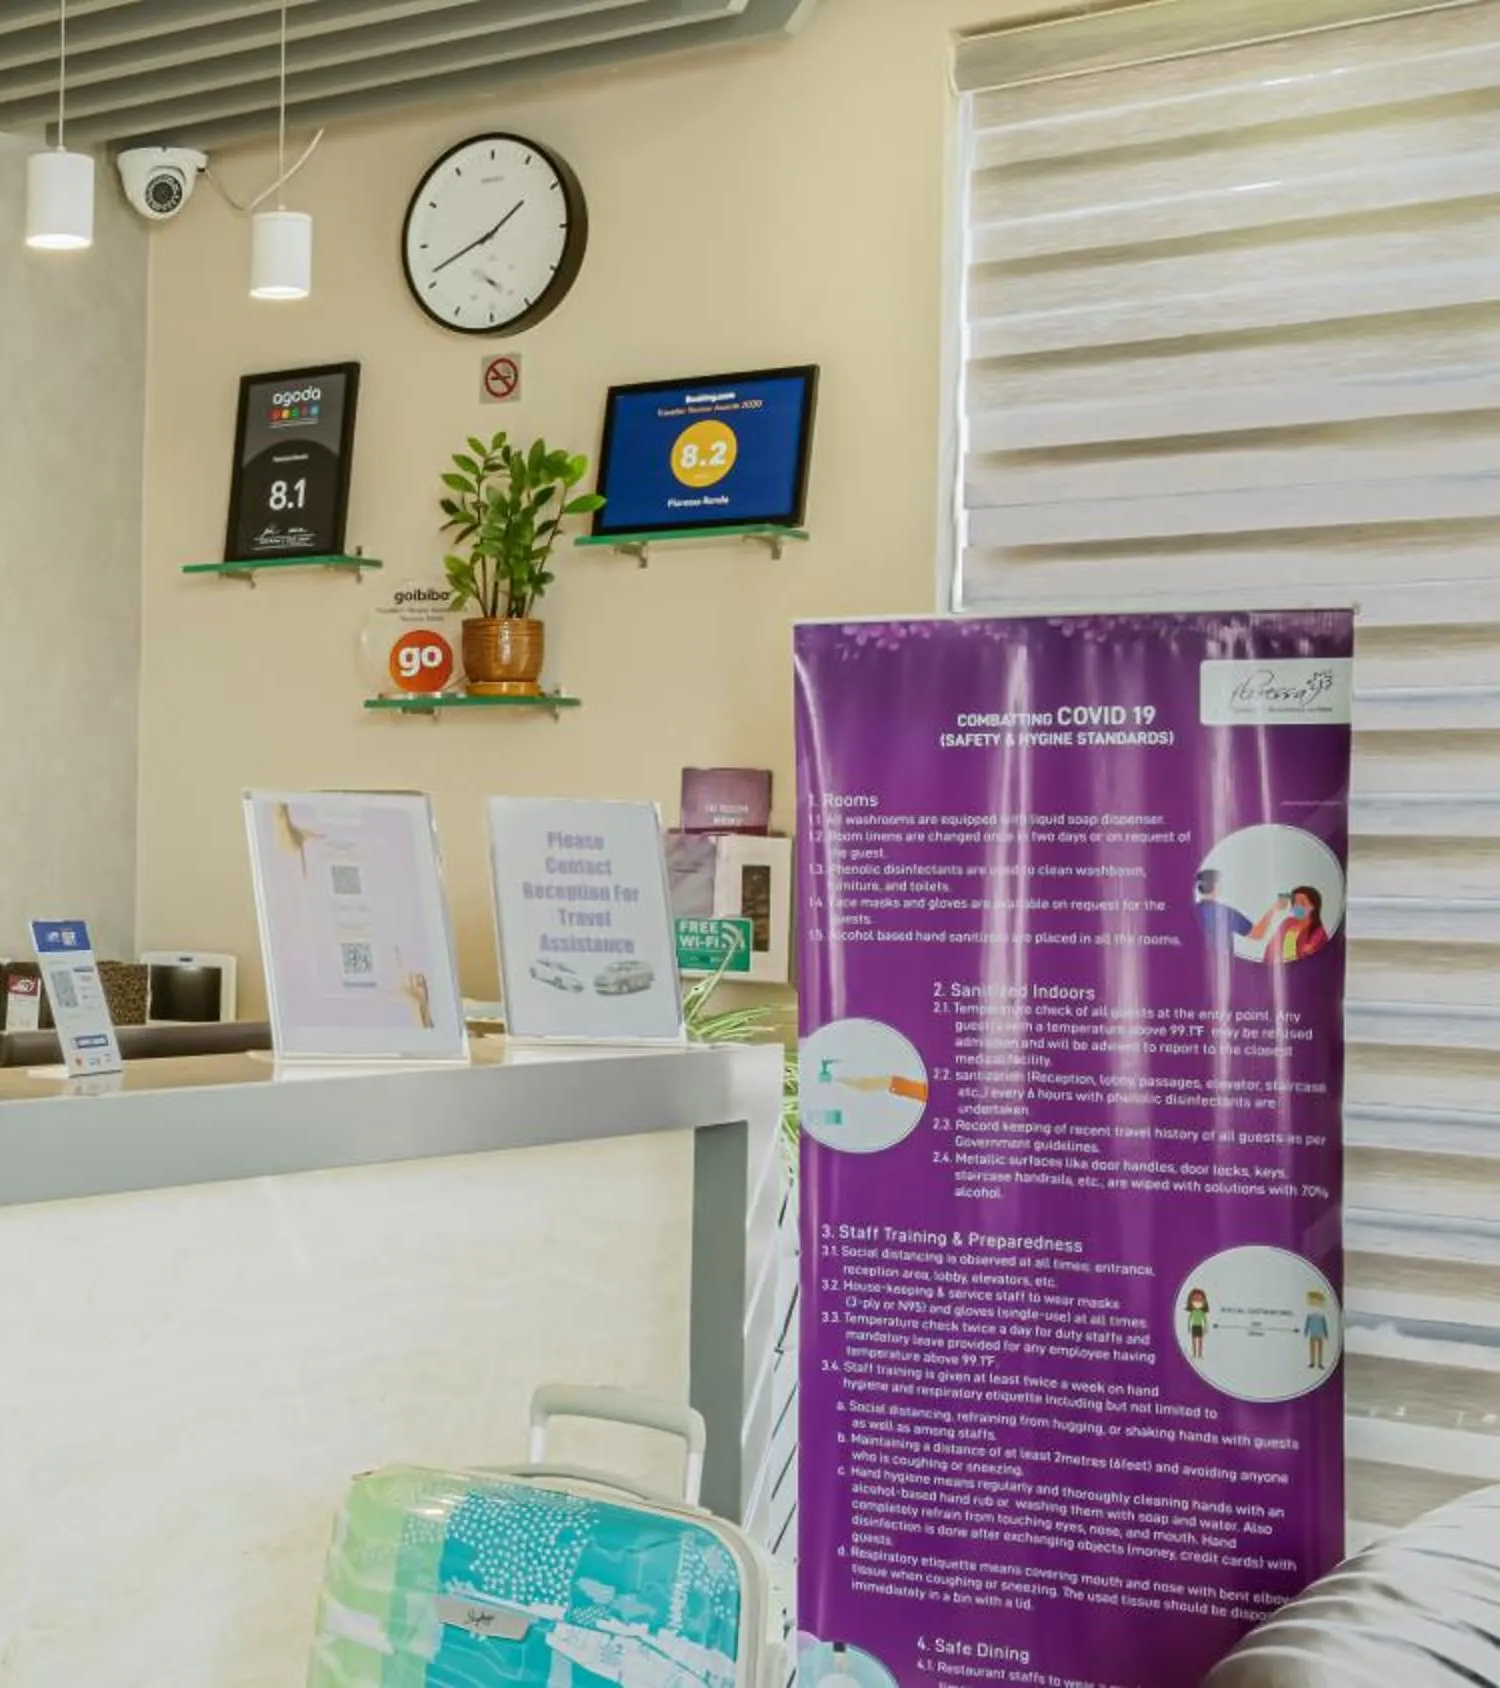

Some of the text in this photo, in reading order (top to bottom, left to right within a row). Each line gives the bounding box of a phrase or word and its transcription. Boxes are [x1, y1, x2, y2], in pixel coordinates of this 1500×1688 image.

[272, 385, 322, 406] agoda
[680, 440, 728, 469] 8.2
[269, 477, 307, 510] 8.1
[393, 588, 450, 606] goibibo
[398, 645, 444, 677] go
[956, 706, 1157, 728] COMBATTING COVID 19
[940, 733, 1001, 748] (SAFETY
[1076, 730, 1176, 746] STANDARDS)
[547, 831, 605, 849] Please
[544, 856, 613, 875] Contact
[522, 881, 641, 902] Reception For
[557, 909, 612, 927] Travel
[679, 920, 719, 934] FREE
[539, 933, 636, 954] Assistance
[679, 934, 720, 949] WI-FI
[1031, 984, 1096, 1000] Indoors
[838, 1225, 880, 1242] Staff
[882, 1228, 948, 1250] Training
[950, 1231, 964, 1247] &
[966, 1232, 1084, 1257] Preparedness
[841, 1247, 878, 1259] Social
[880, 1249, 944, 1266] distancing
[959, 1254, 1016, 1268] observed
[843, 1262, 899, 1280] reception
[948, 1288, 993, 1301] service
[995, 1291, 1025, 1303] staff
[1027, 1293, 1041, 1304] to
[1043, 1296, 1074, 1306] wear
[1076, 1296, 1121, 1309] masks
[844, 1313, 919, 1331] Temperature
[921, 1318, 959, 1332] check
[961, 1321, 996, 1334] twice
[1009, 1325, 1032, 1339] day
[1034, 1326, 1052, 1338] for
[1054, 1328, 1083, 1343] duty
[1085, 1330, 1123, 1343] staffs
[1125, 1333, 1151, 1345] and
[845, 1328, 1157, 1365] mandatory leave provided for any employee having
[850, 1434, 920, 1453] Maintaining
[932, 1441, 986, 1456] distance
[988, 1446, 1001, 1458] of
[1003, 1448, 1017, 1459] at
[1019, 1449, 1051, 1462] least
[1154, 1461, 1179, 1474] and
[1181, 1464, 1237, 1482] avoiding
[1239, 1471, 1290, 1487] anyone
[851, 1450, 877, 1463] who
[879, 1453, 889, 1464] is
[891, 1454, 948, 1472] coughing
[950, 1461, 963, 1471] or
[851, 1498, 918, 1518] completely
[920, 1505, 962, 1520] refrain
[964, 1510, 994, 1523] from
[996, 1513, 1052, 1532] touching
[1124, 1526, 1150, 1539] and
[1200, 1534, 1238, 1548] Hand
[933, 1637, 973, 1655] Safe
[975, 1641, 1030, 1666] Dining
